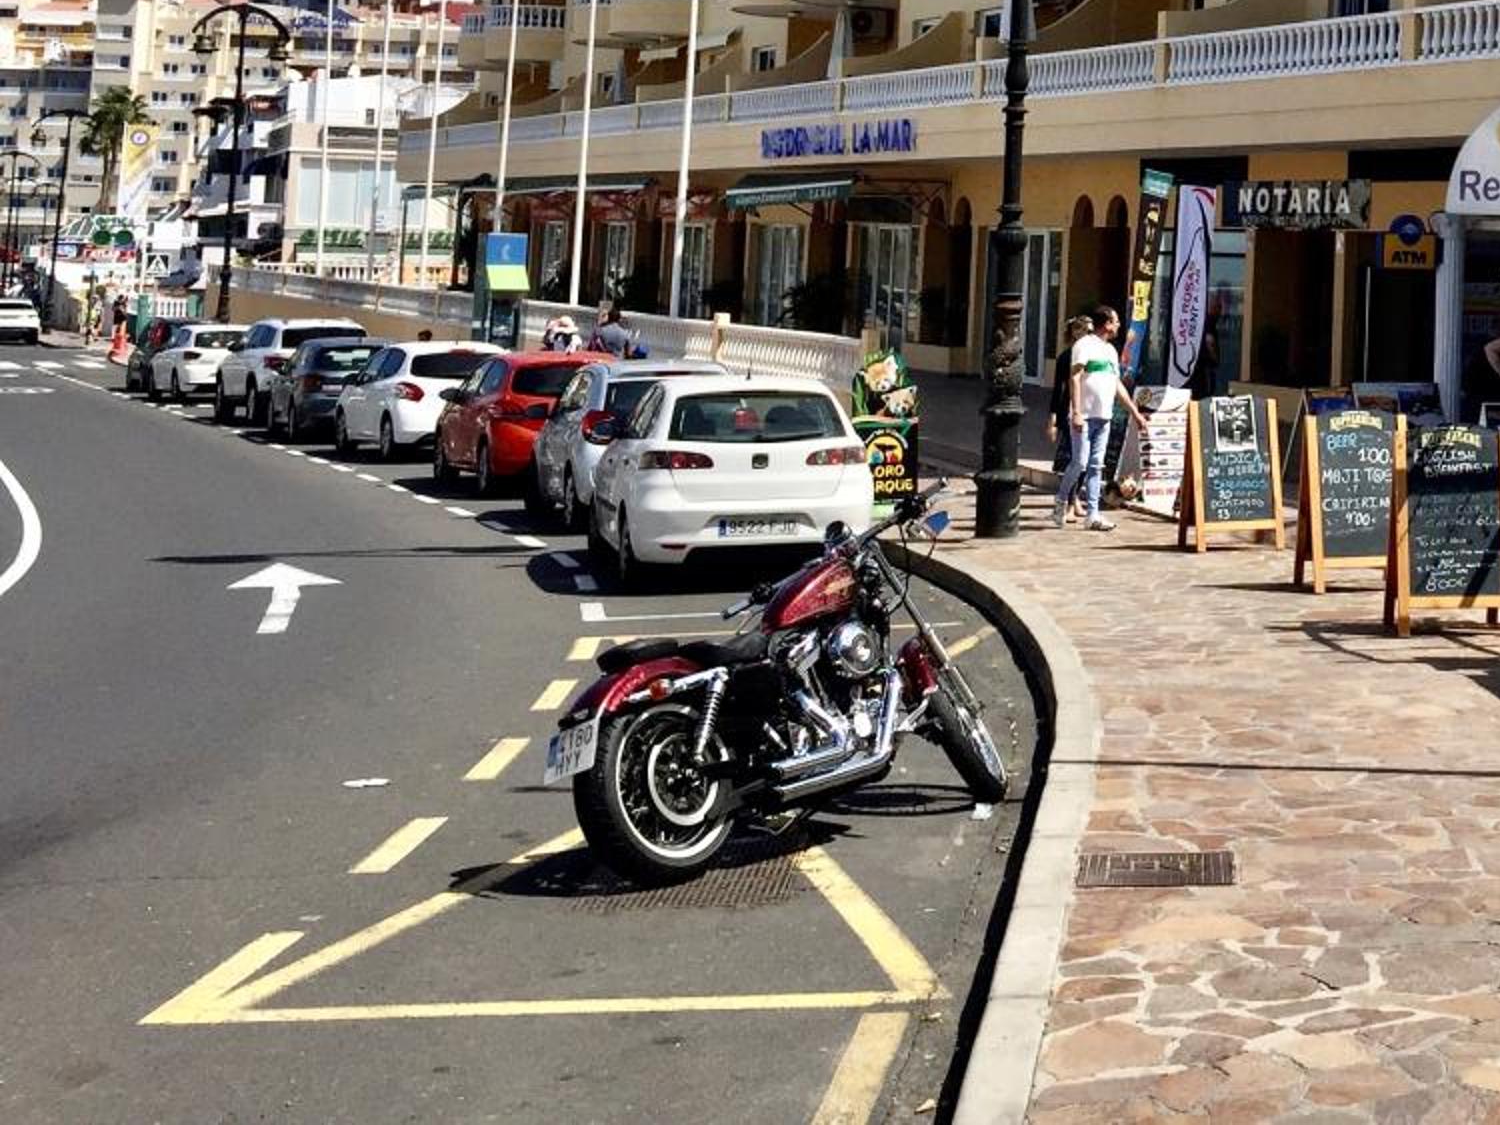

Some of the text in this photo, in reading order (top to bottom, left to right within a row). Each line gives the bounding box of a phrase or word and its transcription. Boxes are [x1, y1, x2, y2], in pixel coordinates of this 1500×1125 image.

[1238, 180, 1350, 214] NOTARÍA
[1391, 250, 1428, 265] ATM
[1178, 318, 1188, 346] LAS
[874, 464, 905, 478] ORO
[875, 479, 913, 494] RQUE
